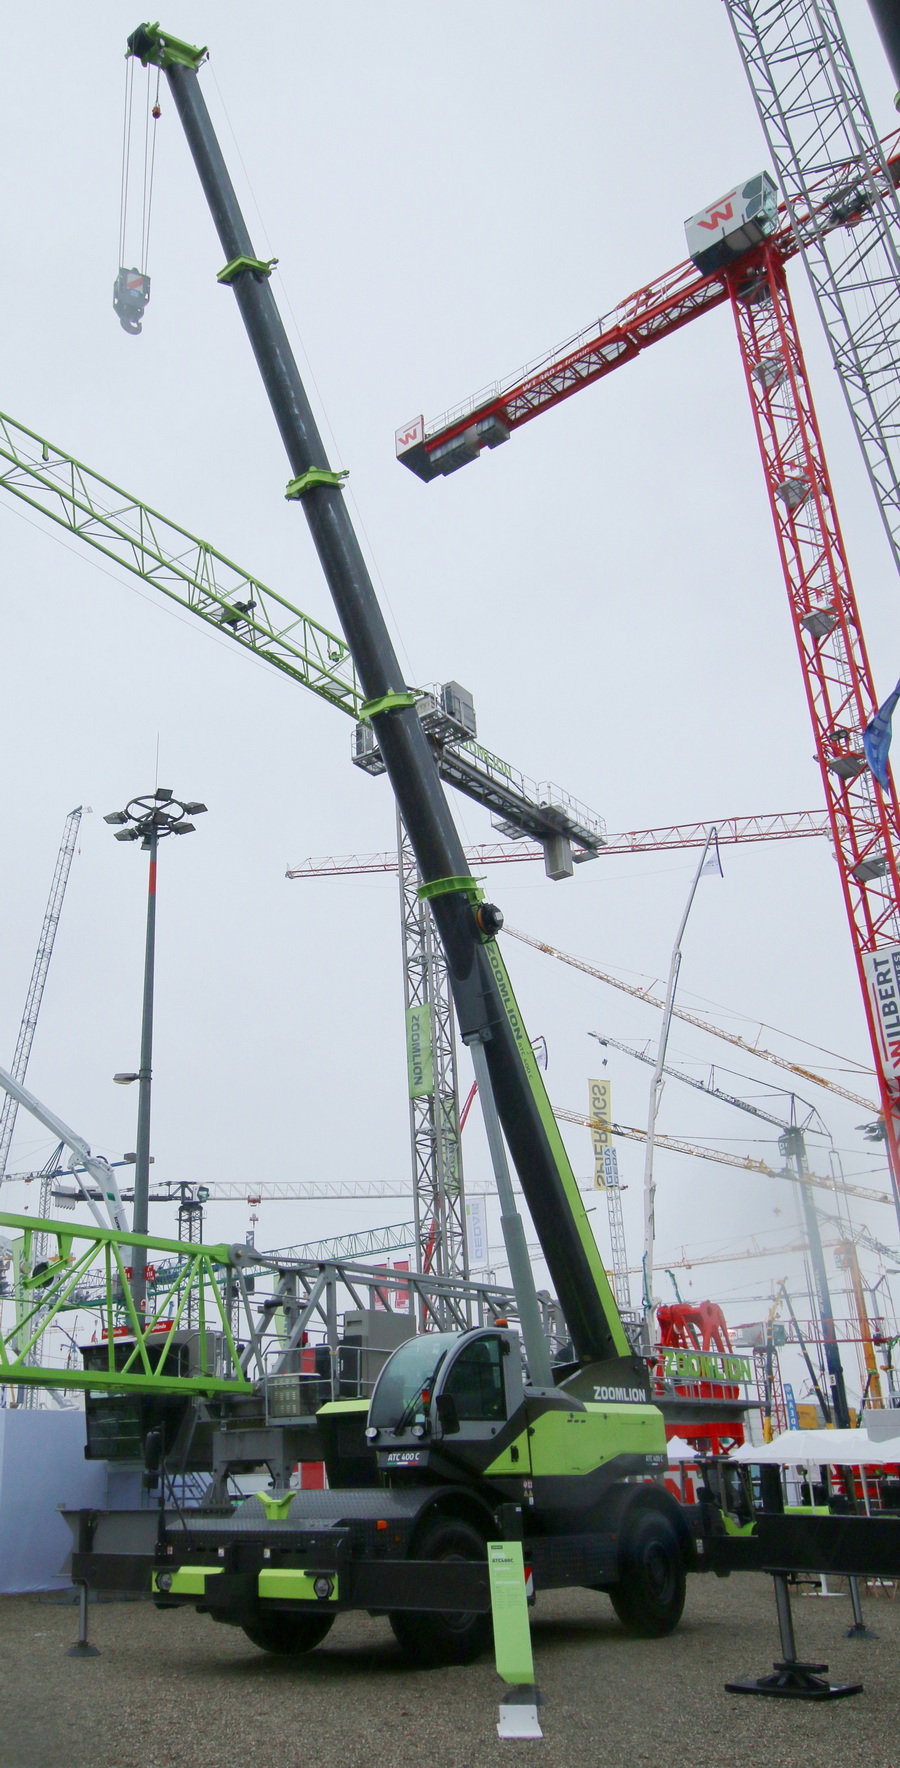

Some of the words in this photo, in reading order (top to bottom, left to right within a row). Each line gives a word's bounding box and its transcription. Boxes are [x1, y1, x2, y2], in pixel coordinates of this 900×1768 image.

[486, 944, 523, 1041] ZOOMLION
[411, 1014, 423, 1086] ZOOMLION
[604, 1147, 613, 1185] GEDA
[663, 1352, 752, 1382] ZOOMLION
[593, 1386, 646, 1402] ZOOMLION
[388, 1453, 401, 1461] ATC
[401, 1452, 414, 1461] 400
[415, 1452, 420, 1460] C
